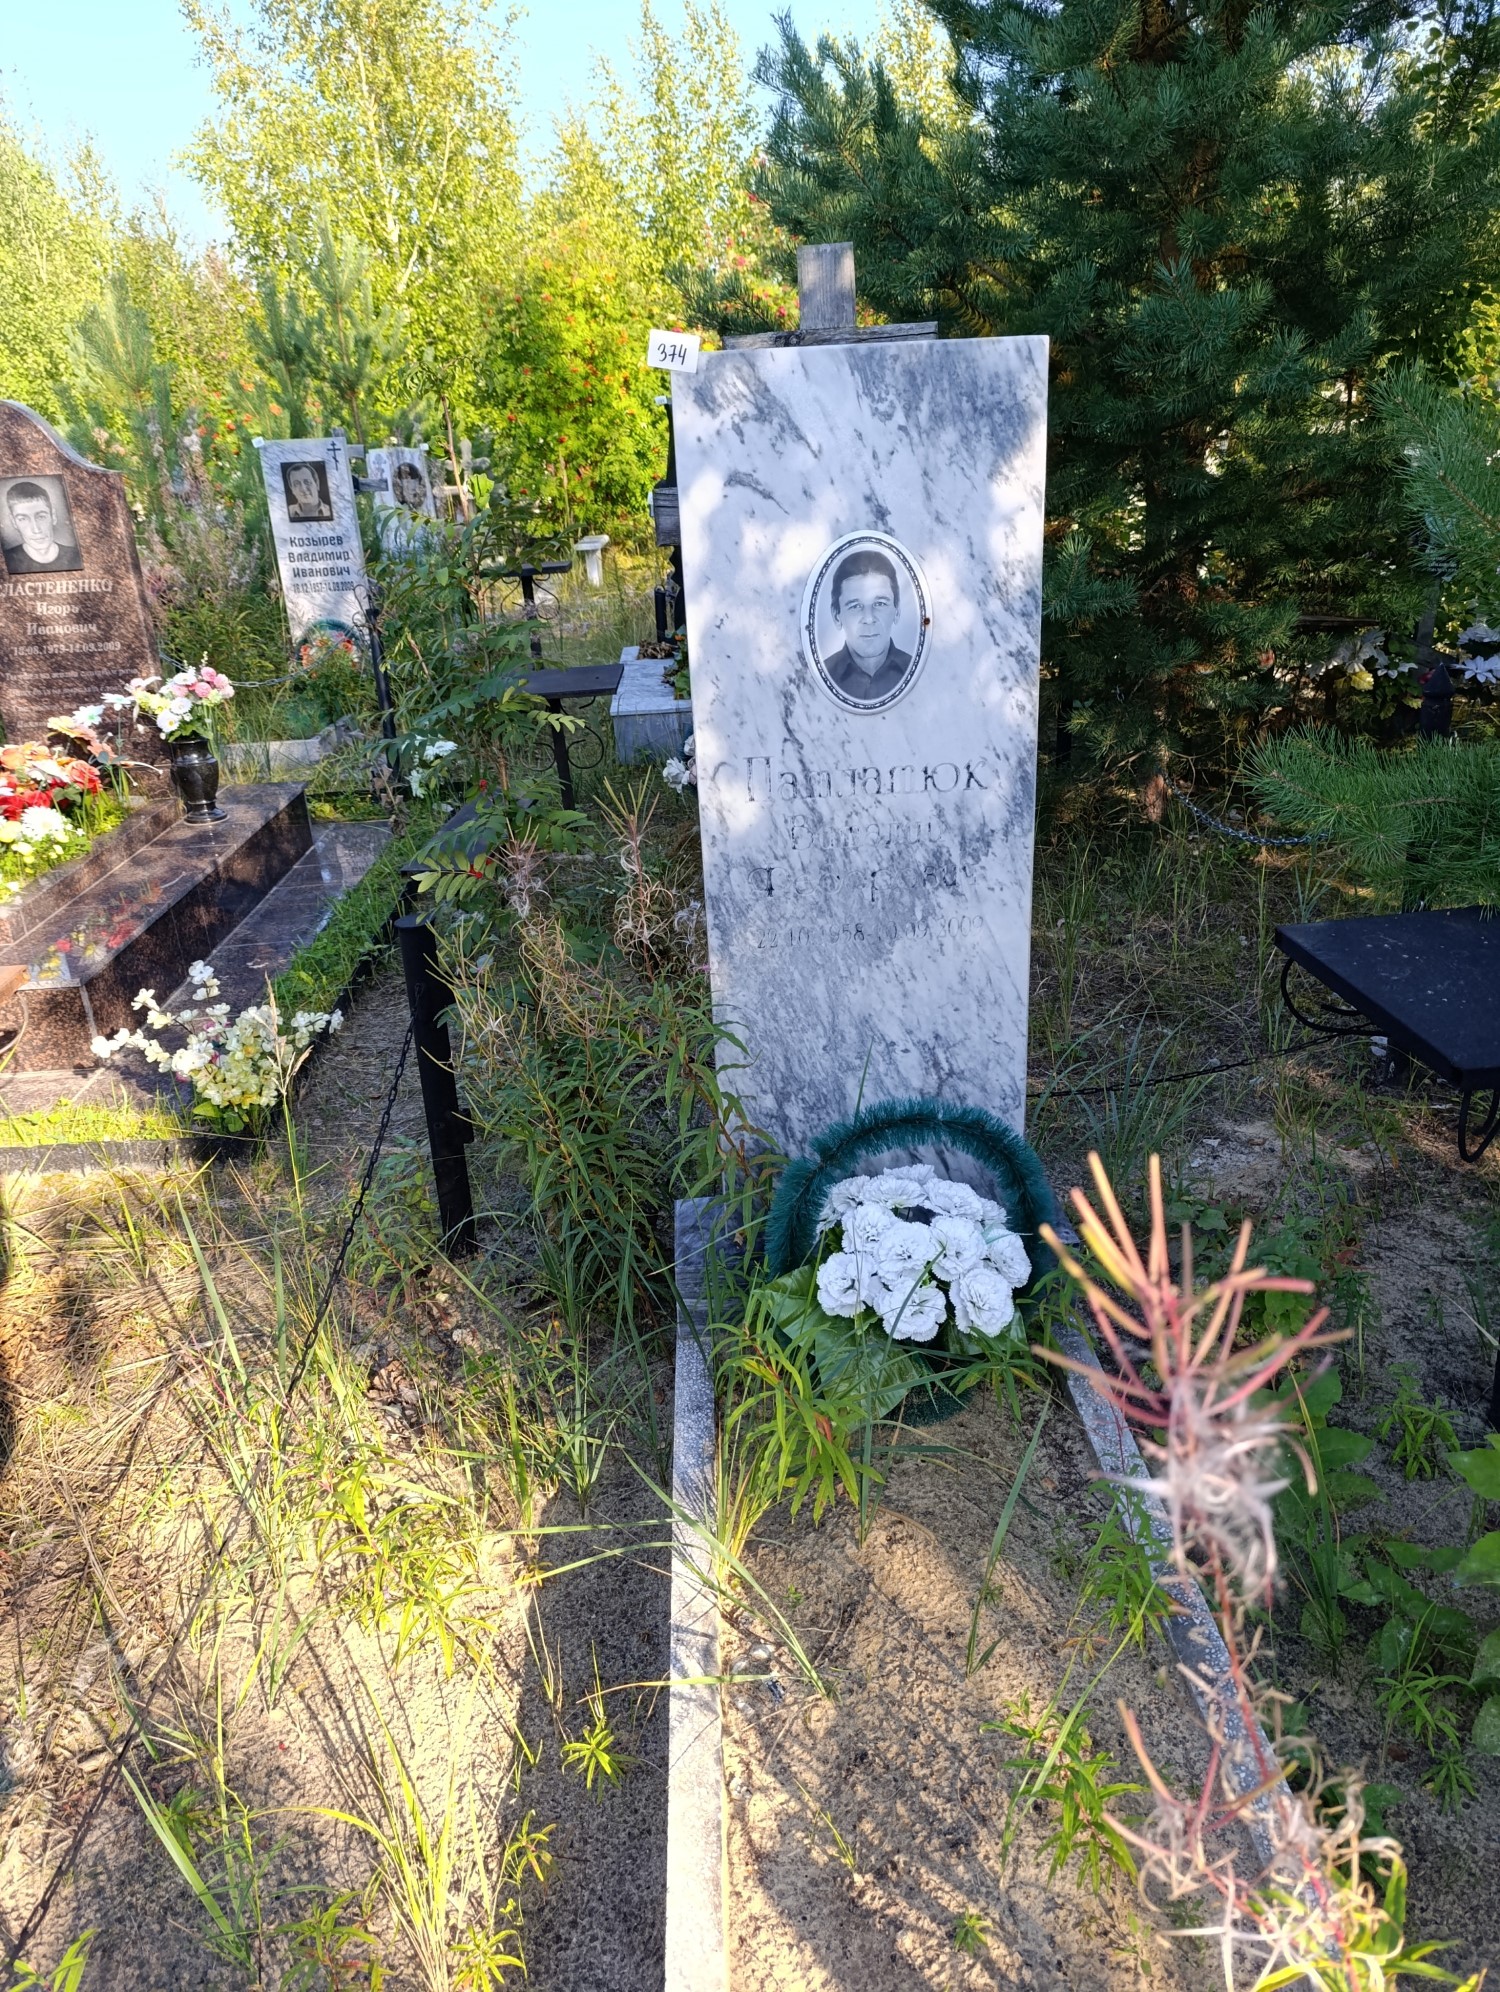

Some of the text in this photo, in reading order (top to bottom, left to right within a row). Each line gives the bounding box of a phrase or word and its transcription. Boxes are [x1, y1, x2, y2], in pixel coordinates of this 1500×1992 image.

[657, 343, 687, 366] 374
[289, 535, 344, 548] Козырев
[288, 550, 350, 563] Владимир
[292, 566, 351, 578] Иванович
[36, 601, 80, 617] Игорь
[26, 622, 98, 636] Иванович
